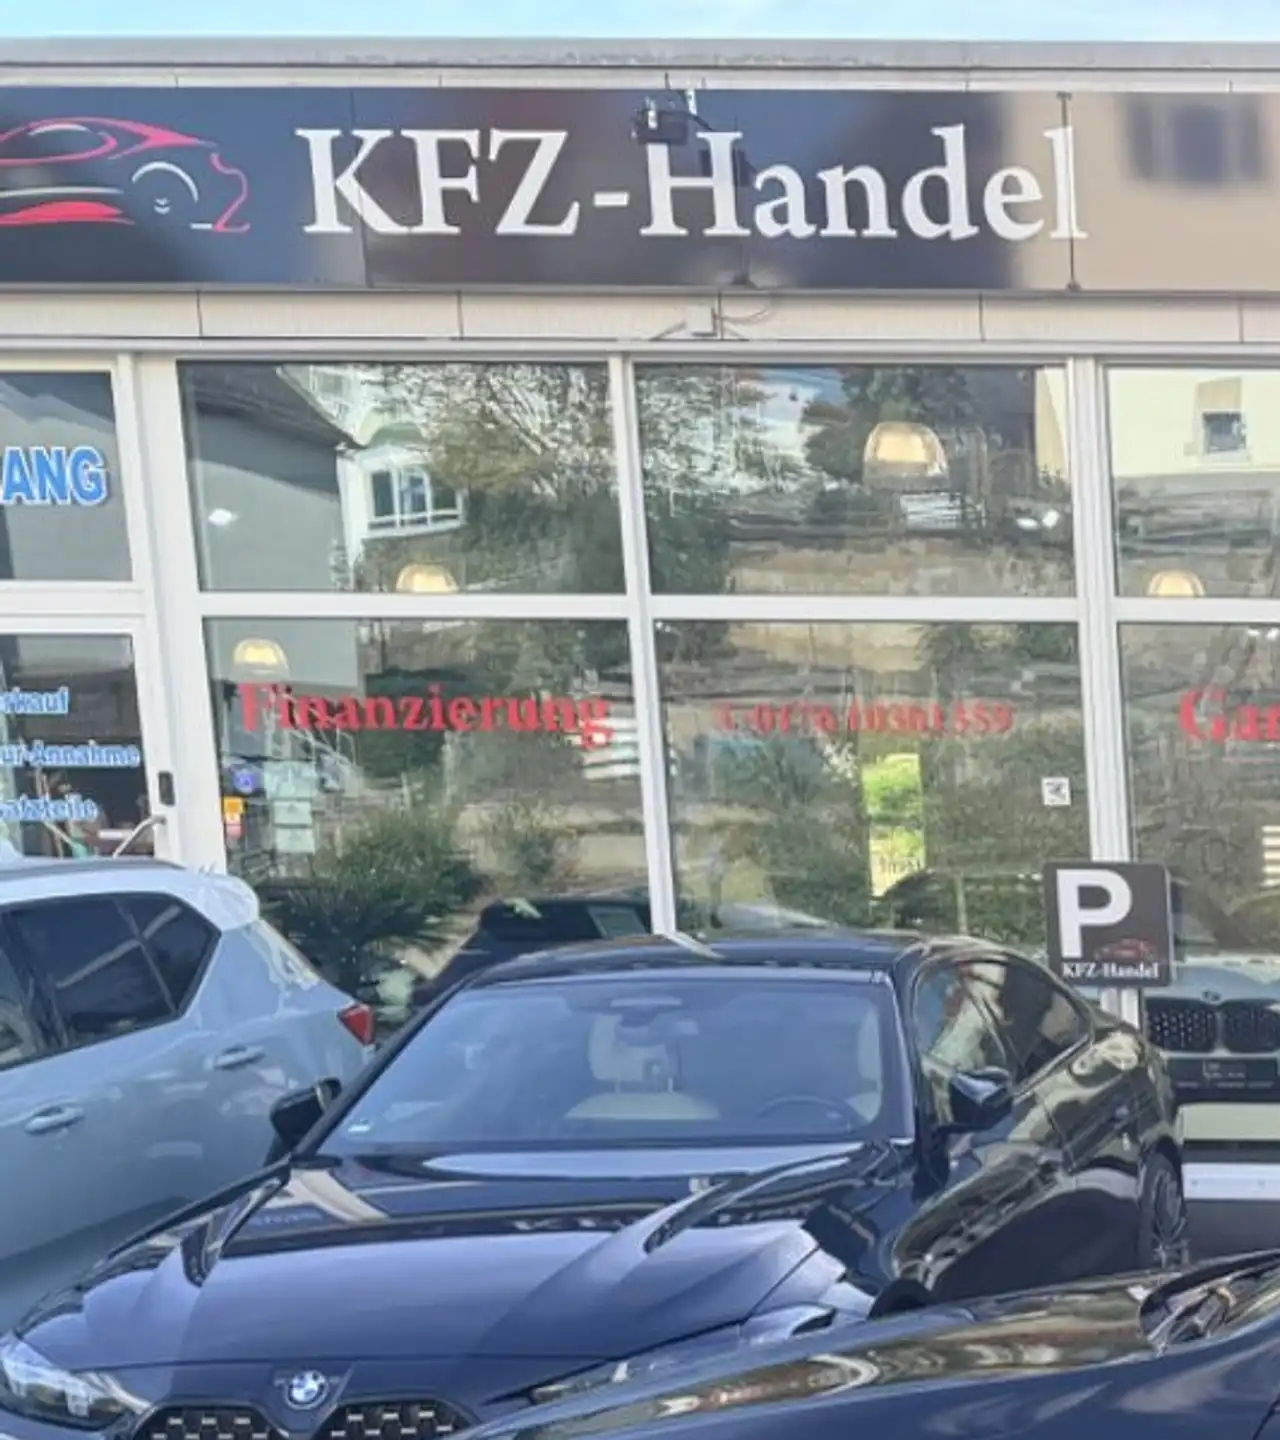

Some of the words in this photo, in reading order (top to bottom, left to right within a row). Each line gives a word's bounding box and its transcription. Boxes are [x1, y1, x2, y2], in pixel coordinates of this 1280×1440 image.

[295, 123, 1089, 240] KFZ-Handel
[1, 446, 108, 505] ANG
[237, 682, 615, 750] Finanzierung
[1056, 868, 1132, 959] P
[1062, 962, 1160, 978] KFZ-Handel
